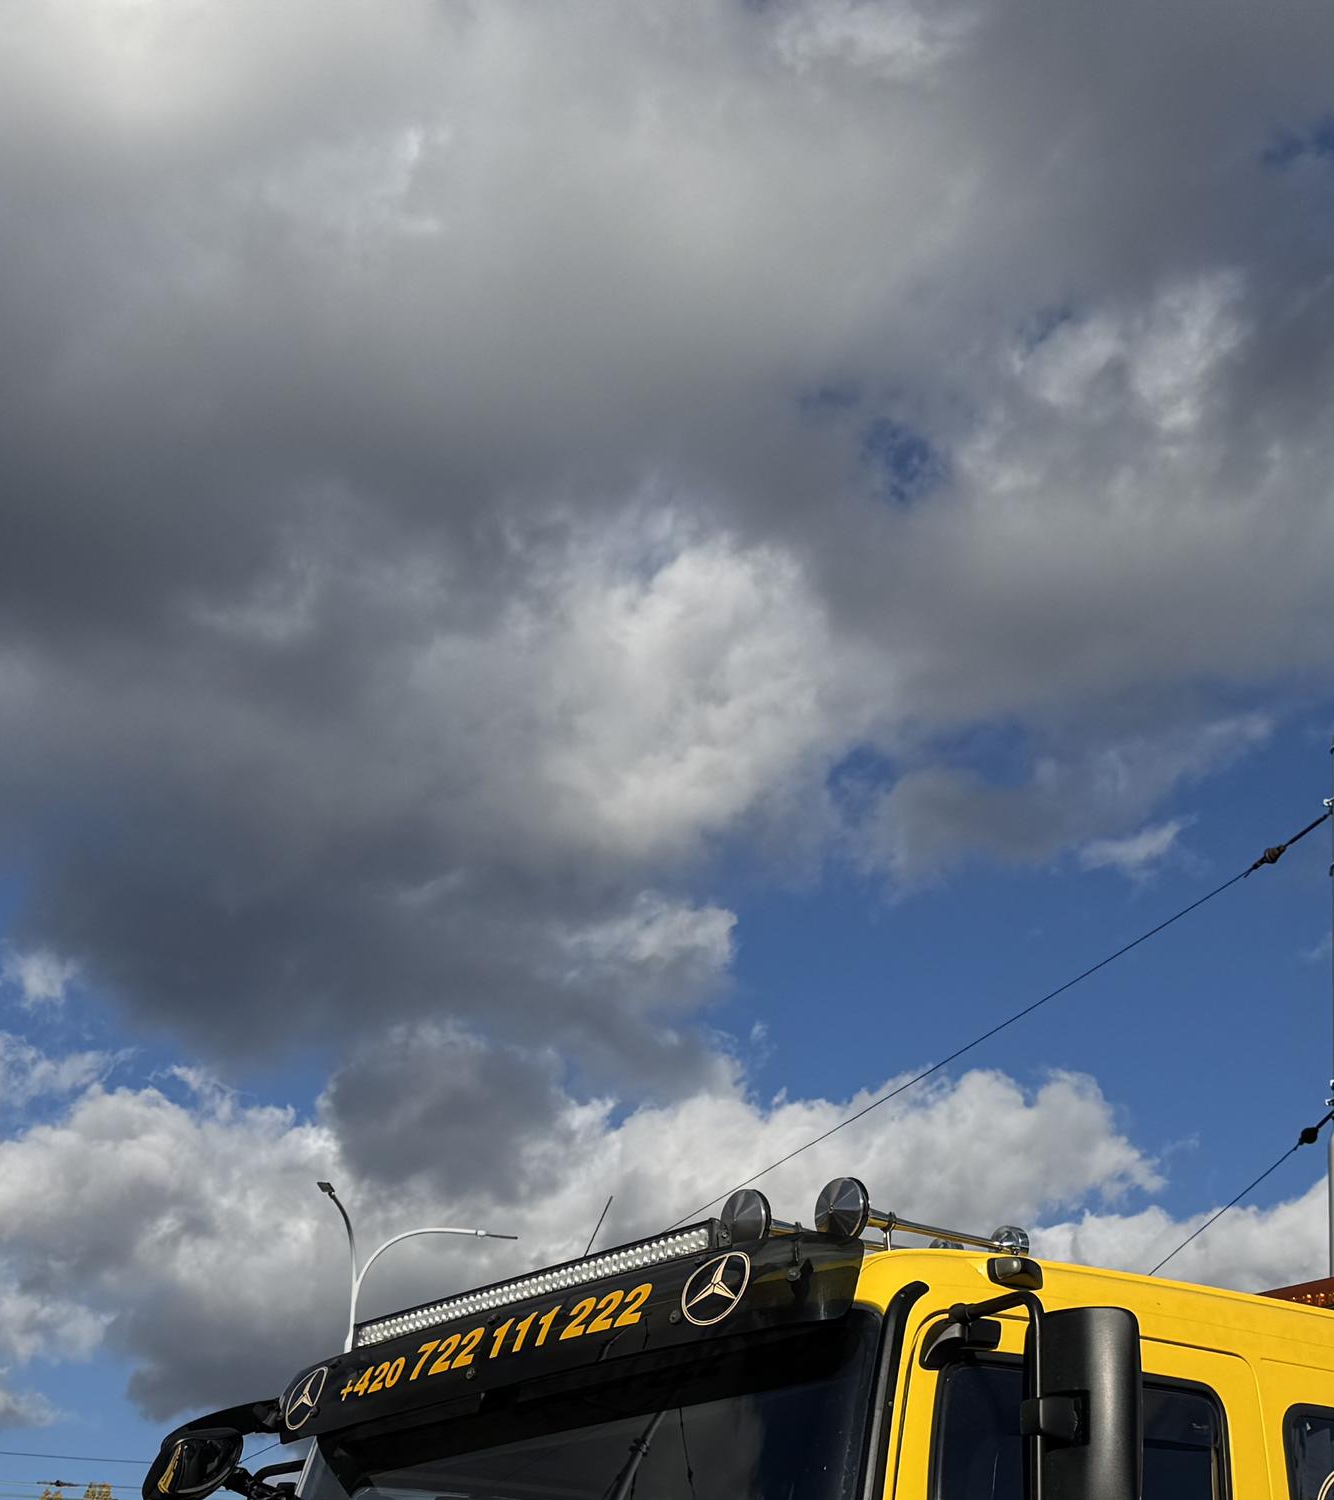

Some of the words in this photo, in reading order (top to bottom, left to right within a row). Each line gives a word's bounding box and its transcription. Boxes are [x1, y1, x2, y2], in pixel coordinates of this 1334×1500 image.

[340, 1356, 406, 1402] +420
[409, 1327, 486, 1382] 722
[489, 1305, 563, 1359] 111
[559, 1283, 653, 1341] 222
